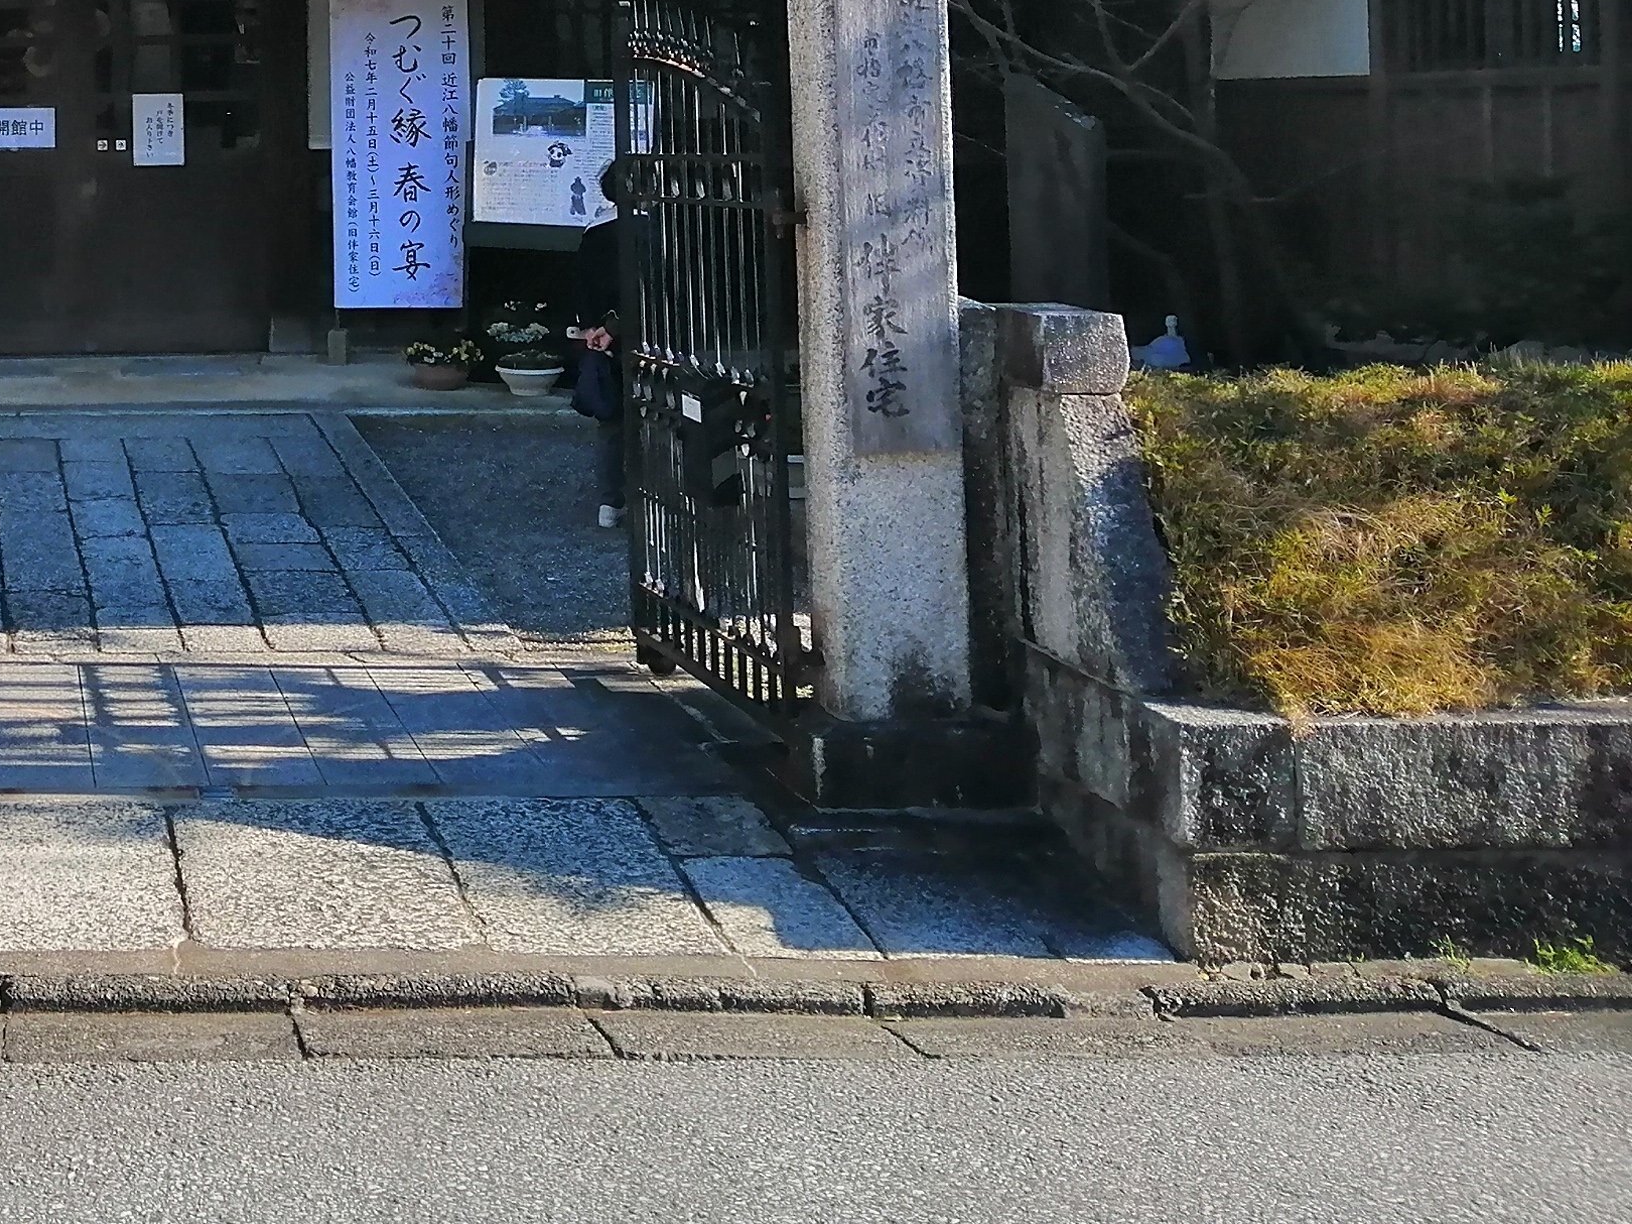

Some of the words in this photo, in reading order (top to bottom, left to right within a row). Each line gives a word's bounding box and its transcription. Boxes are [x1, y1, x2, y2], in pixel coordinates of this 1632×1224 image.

[389, 15, 432, 148] つむぐ縁
[440, 5, 457, 65] 第二十回
[391, 162, 432, 282] 春の宴
[441, 72, 460, 248] 近江八幡節句人形めぐり
